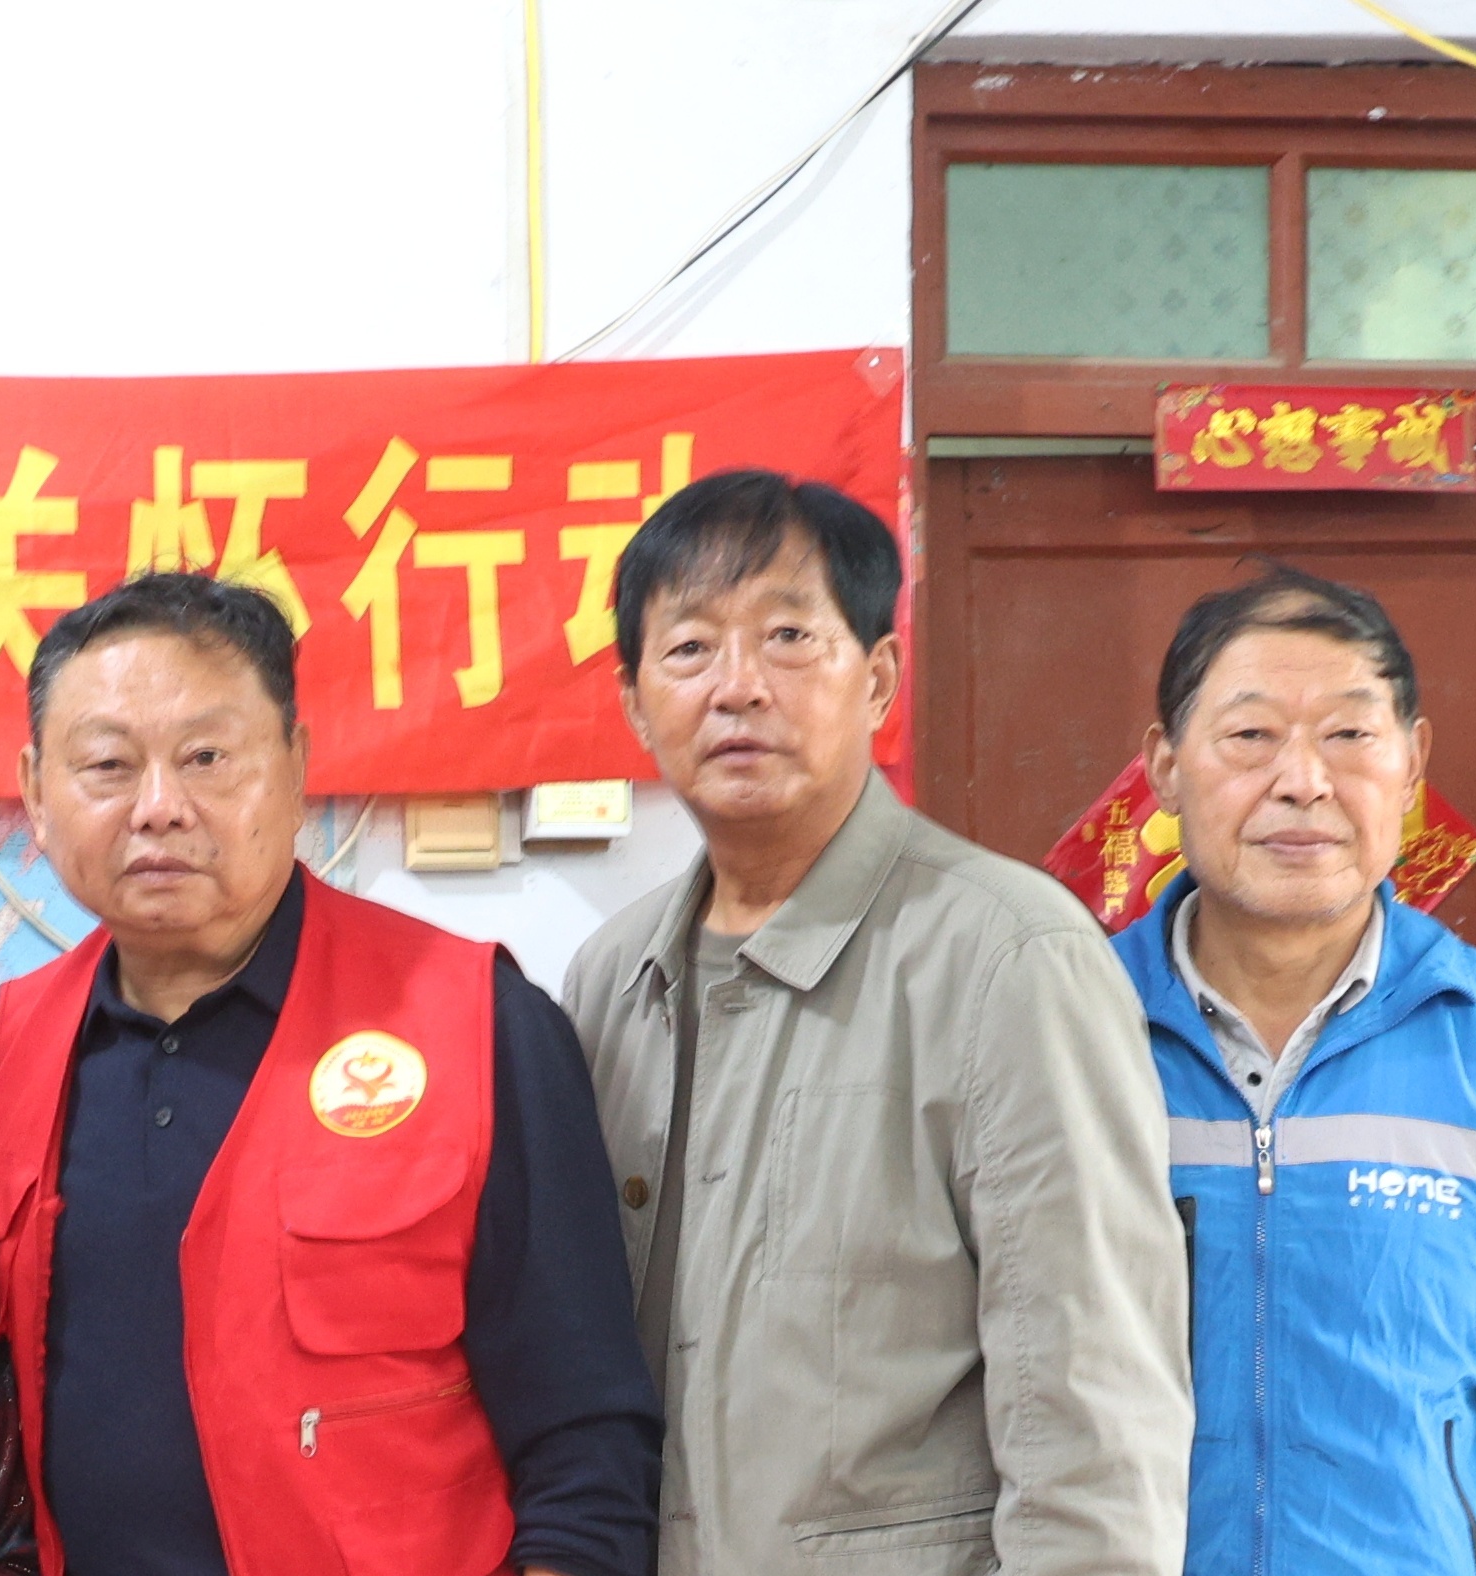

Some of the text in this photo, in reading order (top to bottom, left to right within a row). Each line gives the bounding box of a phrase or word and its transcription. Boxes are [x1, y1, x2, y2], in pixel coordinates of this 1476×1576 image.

[1190, 401, 1448, 474] 心想事成
[1348, 1167, 1462, 1206] HOME
